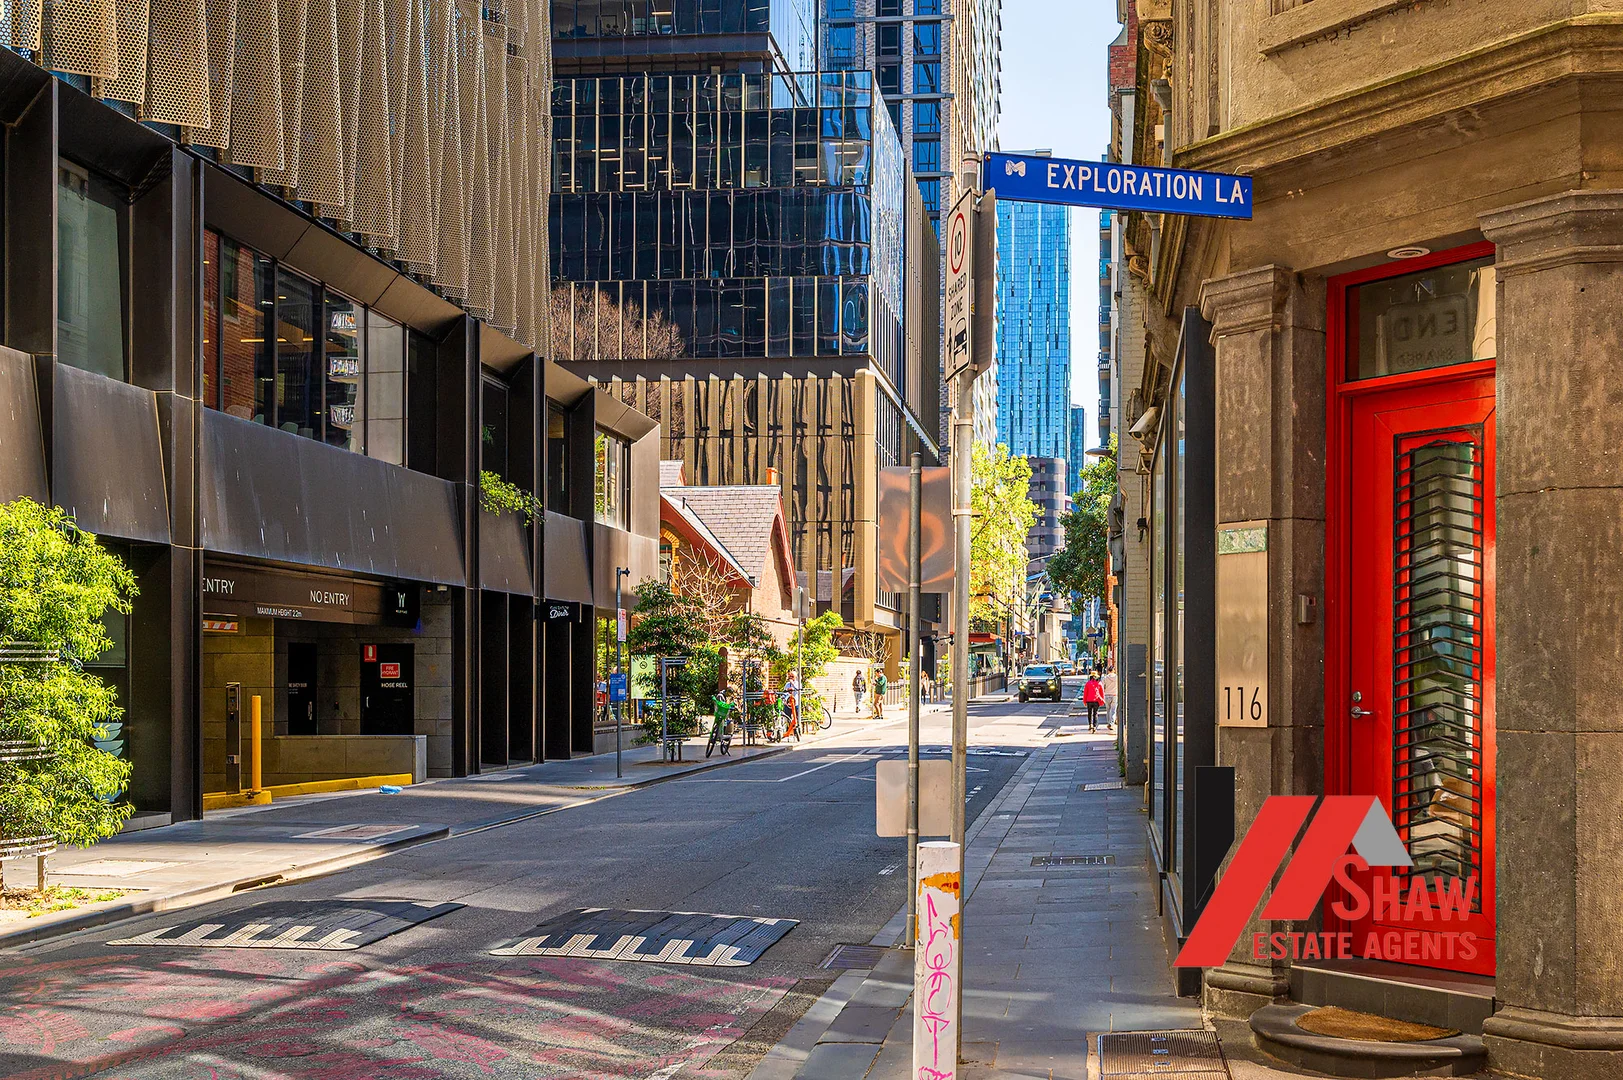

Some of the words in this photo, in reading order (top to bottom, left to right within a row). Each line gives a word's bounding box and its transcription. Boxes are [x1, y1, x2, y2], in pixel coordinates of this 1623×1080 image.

[1047, 163, 1202, 201] EXPLORATION
[1215, 177, 1245, 204] LA
[954, 231, 962, 259] 10
[949, 272, 967, 303] SHARED
[950, 296, 963, 321] ZONE
[257, 607, 278, 616] MAXIMUM
[278, 608, 292, 617] HEIGHT
[310, 590, 323, 603] NO
[324, 591, 349, 606] ENTRY
[1223, 685, 1262, 721] 116
